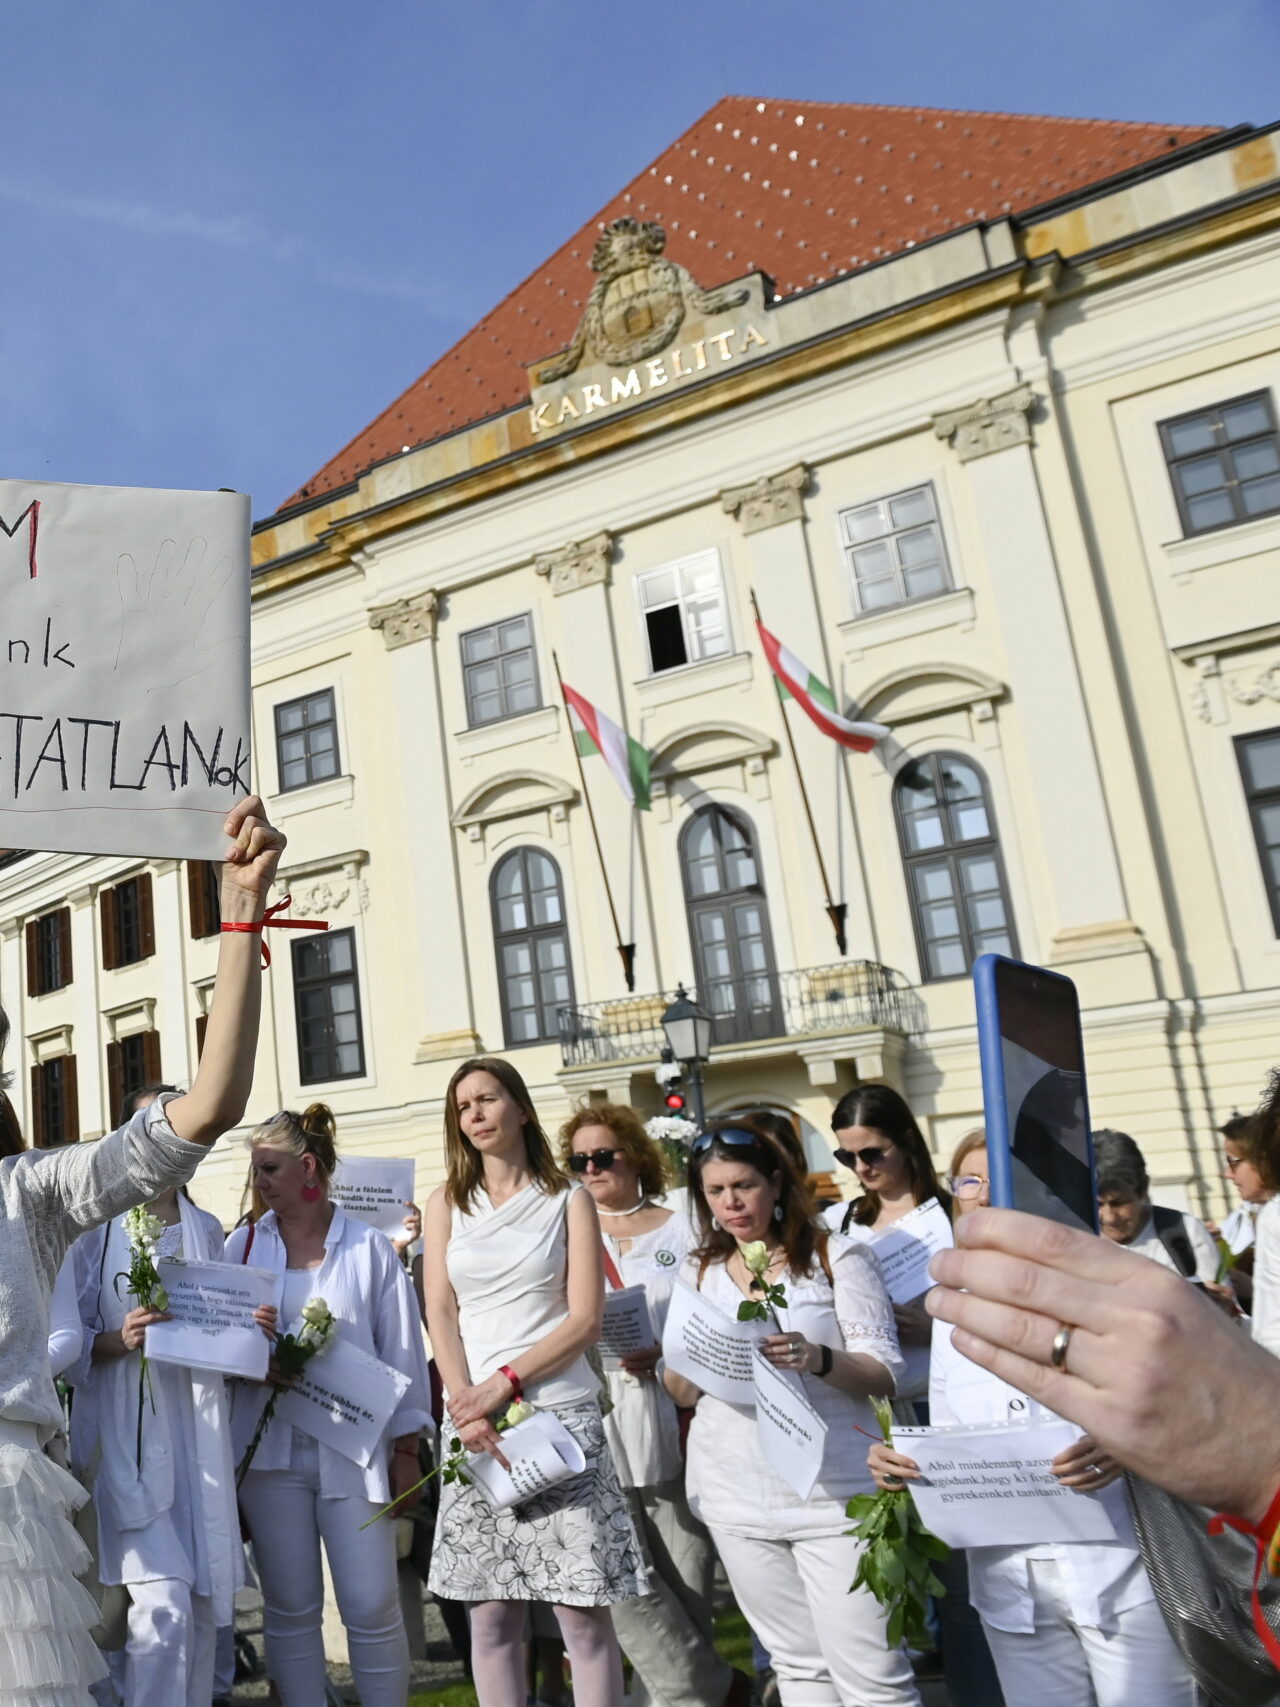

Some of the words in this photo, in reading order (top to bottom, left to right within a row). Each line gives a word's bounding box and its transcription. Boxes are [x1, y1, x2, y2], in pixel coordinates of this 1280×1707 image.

[529, 323, 769, 434] KARMELITA
[177, 1282, 194, 1290] Ahol
[314, 1384, 329, 1396] vér
[330, 1393, 361, 1414] többet
[362, 1410, 374, 1423] ér,
[320, 1400, 359, 1425] szeretet.
[928, 1461, 955, 1472] Ahol
[958, 1460, 1023, 1472] mindennap
[1015, 1474, 1026, 1483] ki
[940, 1490, 1014, 1503] gyerekeinket
